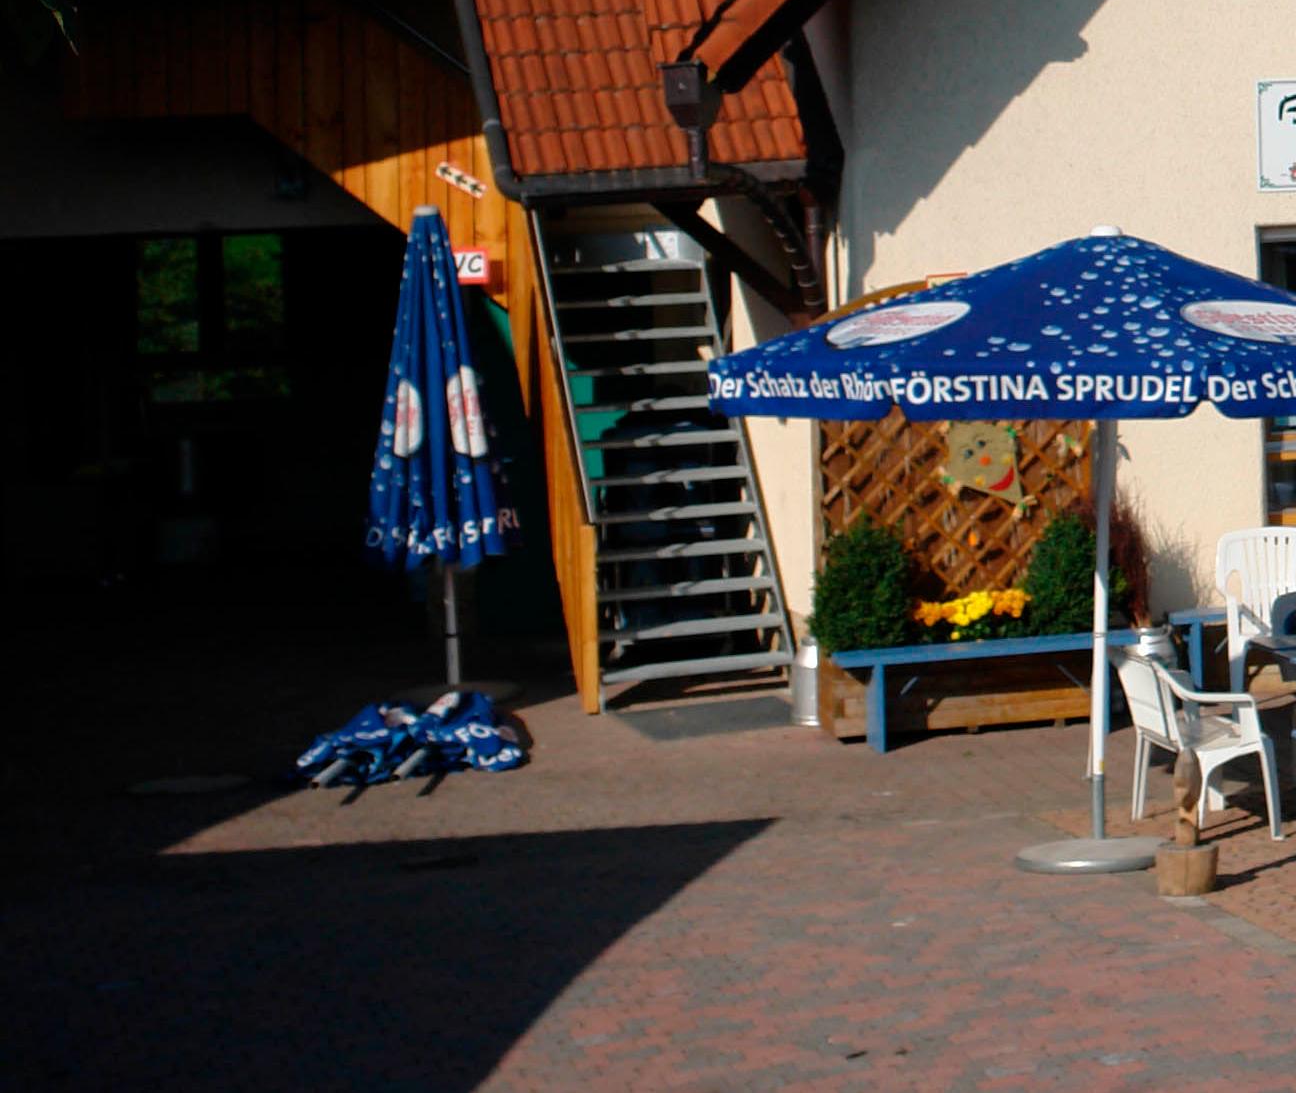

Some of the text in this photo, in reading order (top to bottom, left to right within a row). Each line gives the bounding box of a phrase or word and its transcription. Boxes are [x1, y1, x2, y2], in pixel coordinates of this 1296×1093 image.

[708, 372, 744, 399] Der
[745, 370, 809, 399] Schatz
[809, 371, 841, 399] der
[890, 371, 1198, 405] FÖRSTINA SPRUDEL
[1207, 375, 1258, 403] Der
